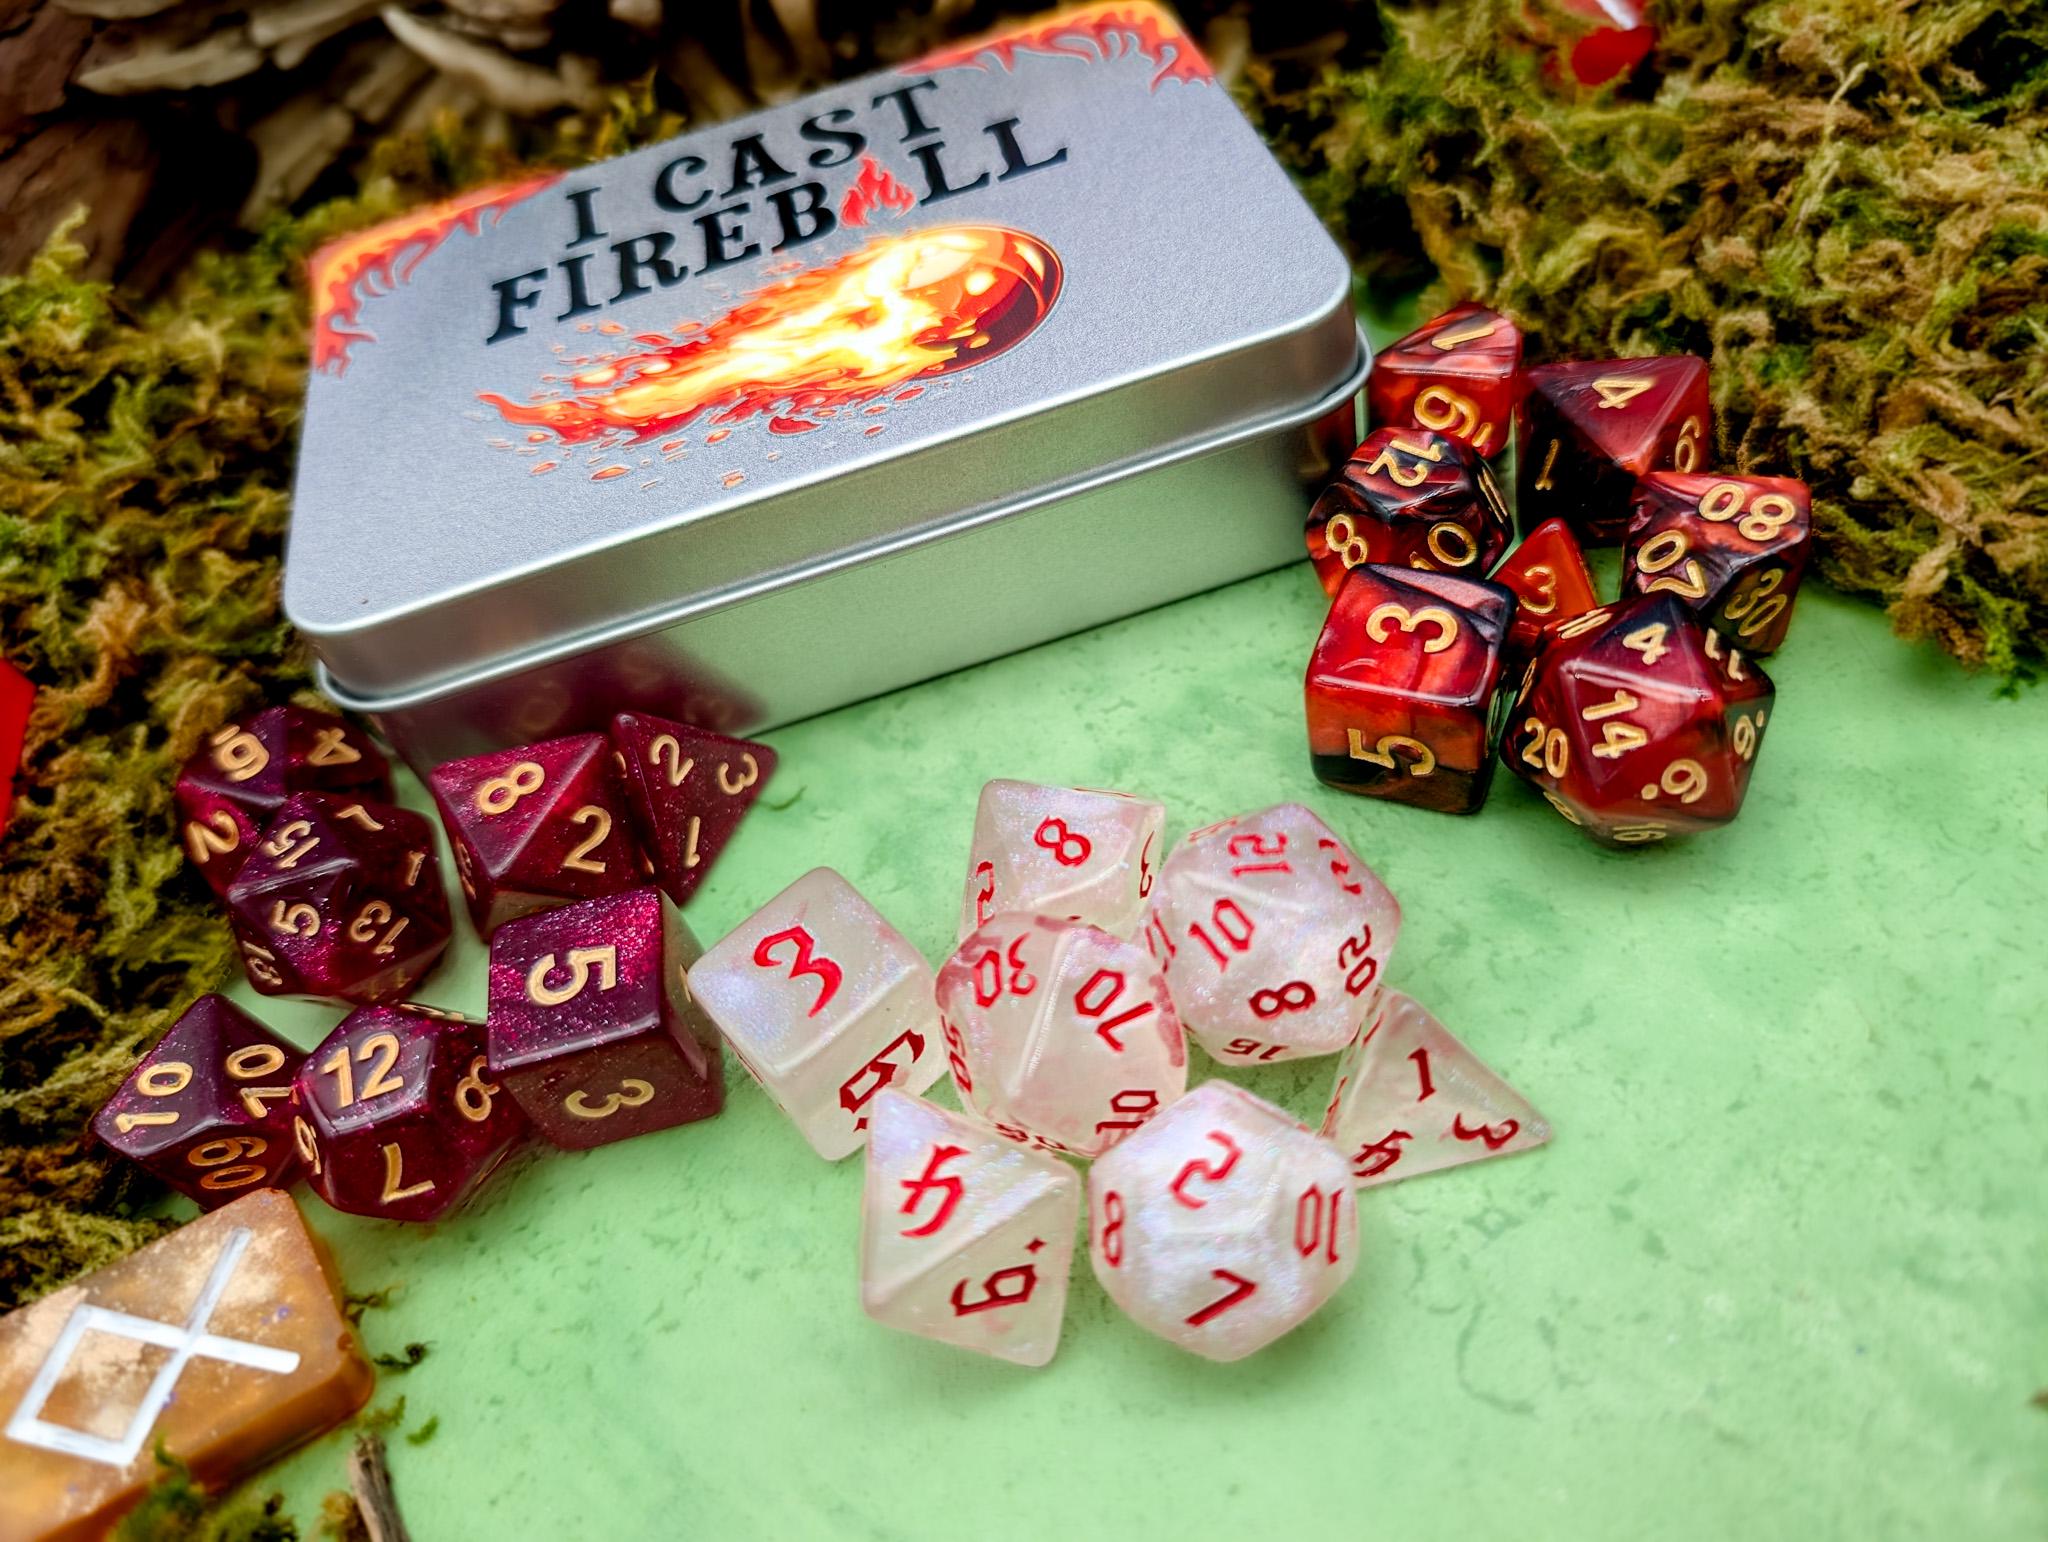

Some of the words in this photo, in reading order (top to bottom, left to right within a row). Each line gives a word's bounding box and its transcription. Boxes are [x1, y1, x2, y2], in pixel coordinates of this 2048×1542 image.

[564, 186, 609, 250] I
[653, 78, 942, 214] CAST
[1431, 326, 1496, 351] 1
[1592, 376, 1657, 410] 4
[1366, 439, 1443, 488] 12
[1535, 438, 1560, 491] 1
[1326, 513, 1368, 570] 8
[1519, 566, 1557, 614] 3
[1366, 602, 1458, 654] 3
[1622, 622, 1671, 666] 4
[307, 727, 362, 767] 4
[1348, 727, 1436, 777] 5
[1522, 717, 1569, 779] 20
[1582, 689, 1649, 759] 14
[476, 760, 546, 816] 8
[651, 734, 695, 787] 2
[718, 752, 760, 796] 3
[185, 809, 240, 864] 2
[260, 819, 321, 869] 15
[562, 804, 613, 874] 2
[683, 815, 701, 869] 1
[1033, 815, 1092, 868] 8
[1226, 831, 1294, 878] 12
[270, 899, 321, 937] 5
[351, 899, 410, 955] 13
[1188, 897, 1256, 972] 10
[526, 945, 617, 1007] 5
[753, 923, 844, 1019] 3
[972, 932, 1039, 1009] 30
[1338, 923, 1378, 997] 20
[1073, 968, 1155, 1053] 70
[1249, 980, 1317, 1020] 8
[114, 1061, 194, 1134] 10
[322, 1032, 404, 1109] 12
[455, 1055, 501, 1123] 8
[564, 1078, 656, 1118] 3
[1408, 1047, 1437, 1104] 1
[1094, 1089, 1160, 1136] 10
[1452, 1112, 1520, 1151] 3
[380, 1141, 436, 1206] 7
[897, 1143, 971, 1238] 4
[1169, 1129, 1244, 1211] 2
[1102, 1190, 1125, 1268] 8
[1294, 1182, 1345, 1267] 10
[1184, 1268, 1259, 1328] 7
